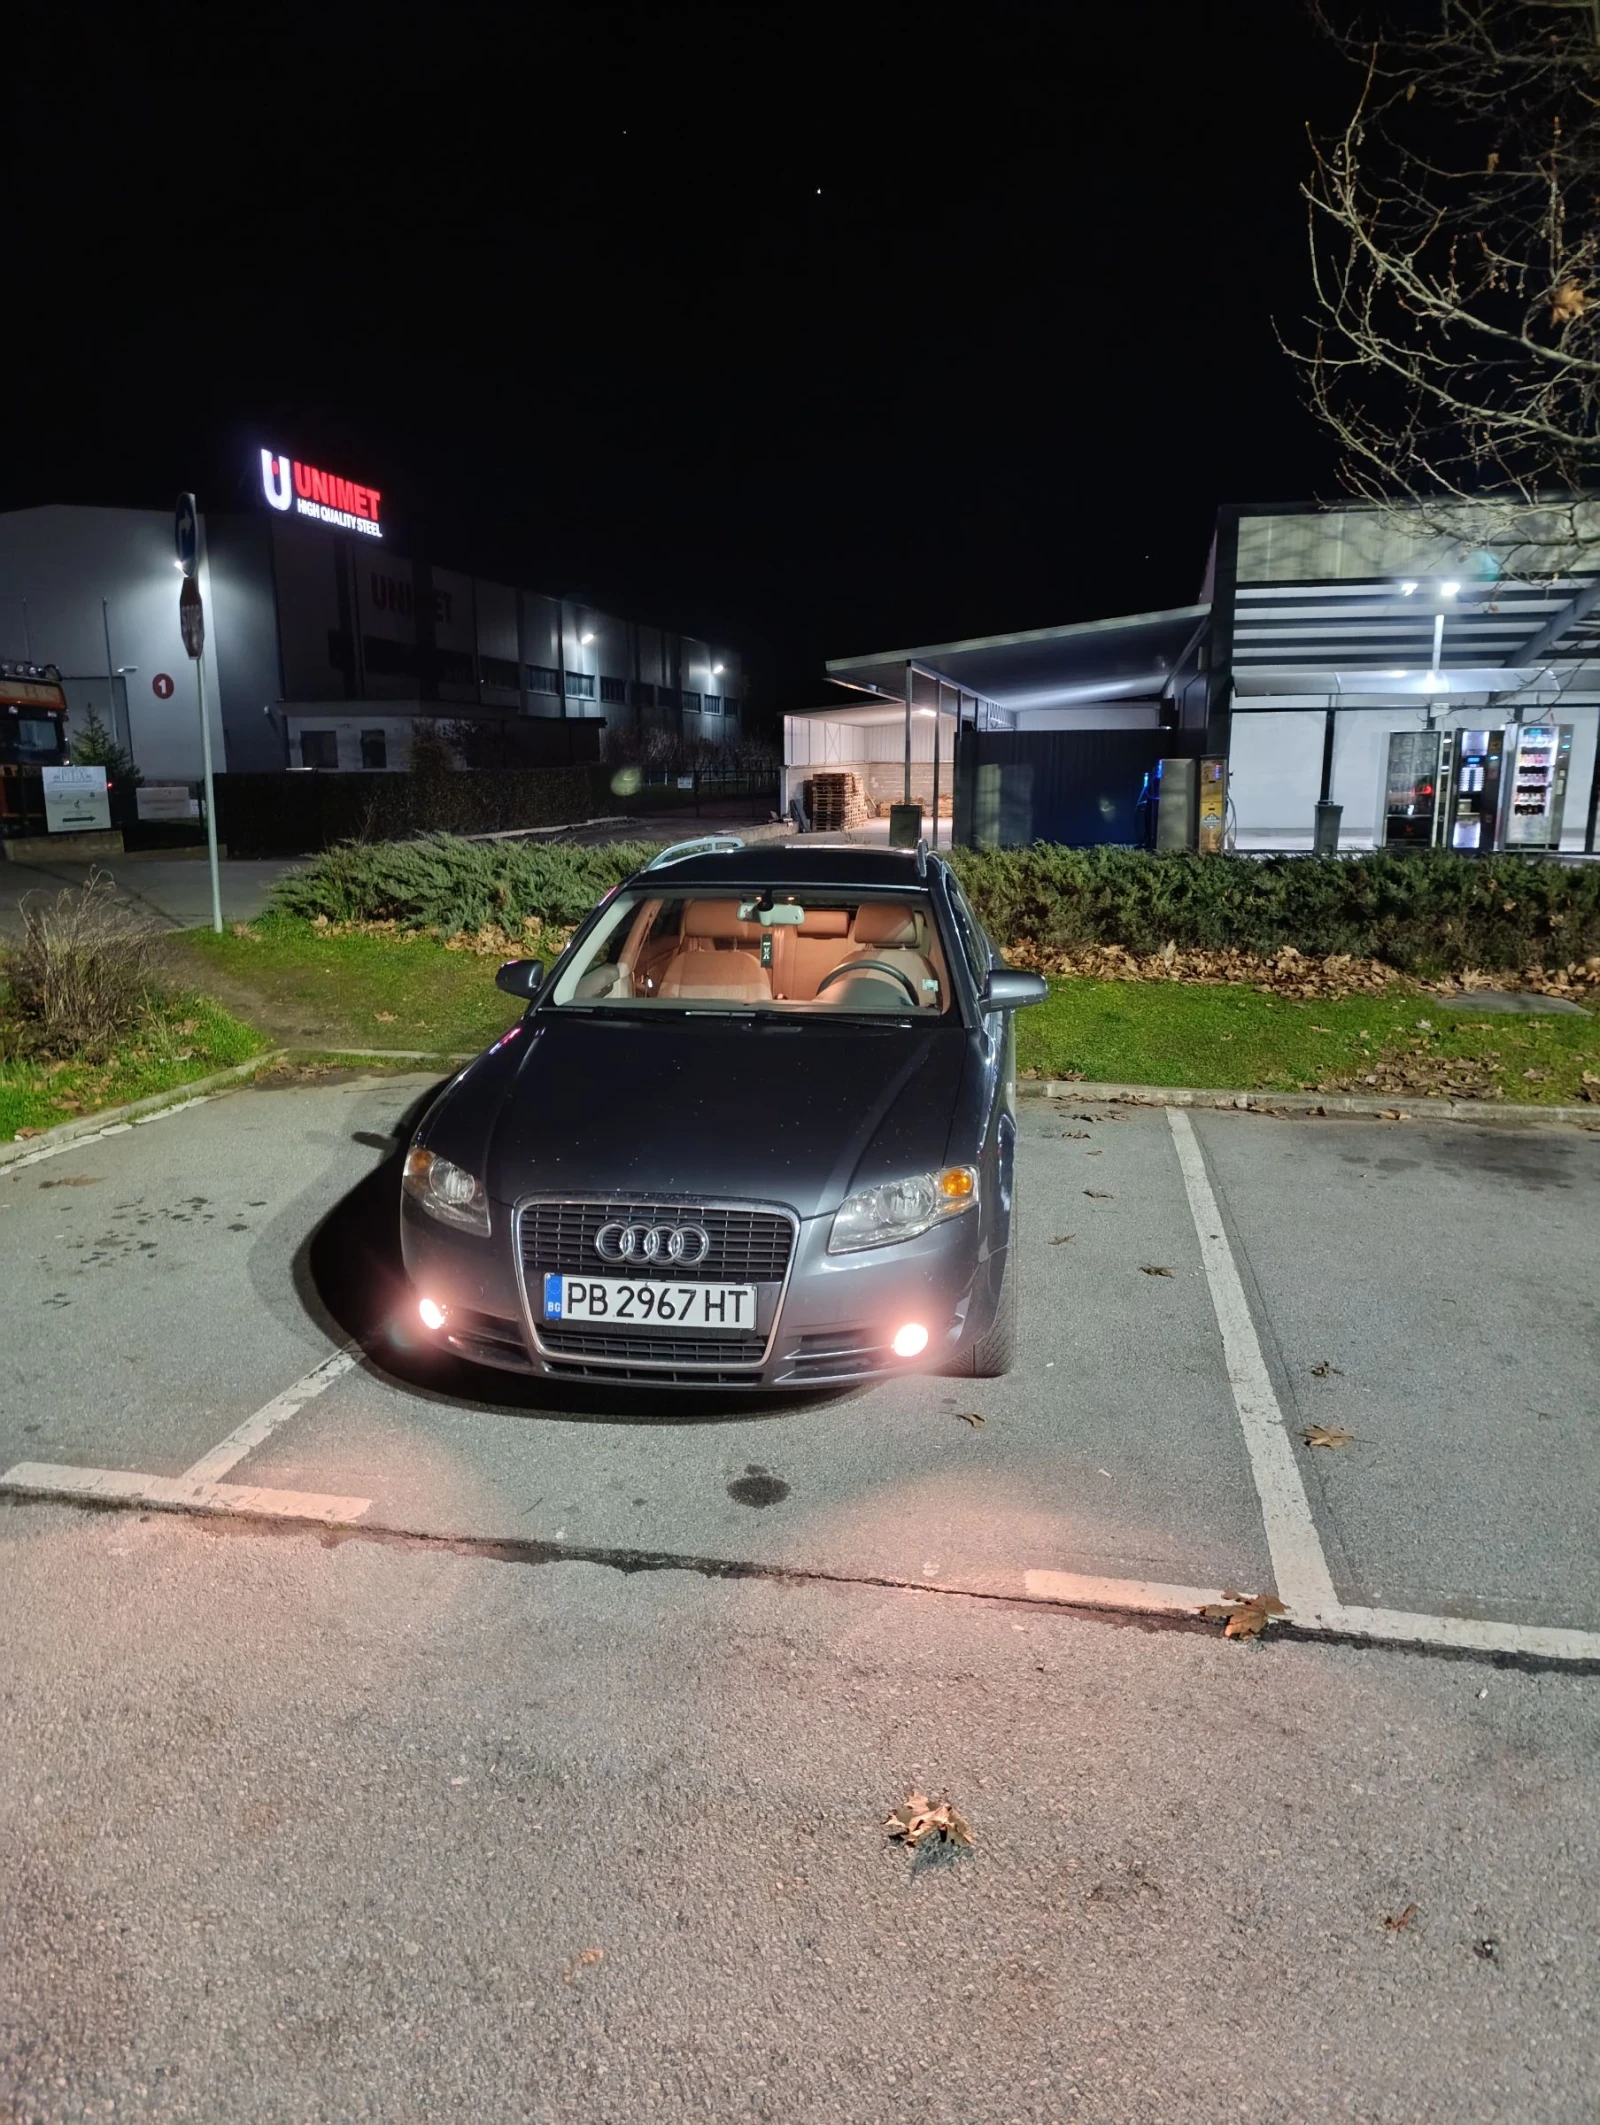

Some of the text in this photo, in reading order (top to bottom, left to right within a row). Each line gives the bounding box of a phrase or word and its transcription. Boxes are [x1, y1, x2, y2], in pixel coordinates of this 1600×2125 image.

[293, 461, 381, 521] UNIMET
[297, 498, 383, 538] HIGH QUALITY STEEL
[371, 572, 452, 623] UNIET
[158, 679, 167, 694] 1
[547, 1301, 561, 1313] BG
[567, 1282, 749, 1323] PB 2967 HT
